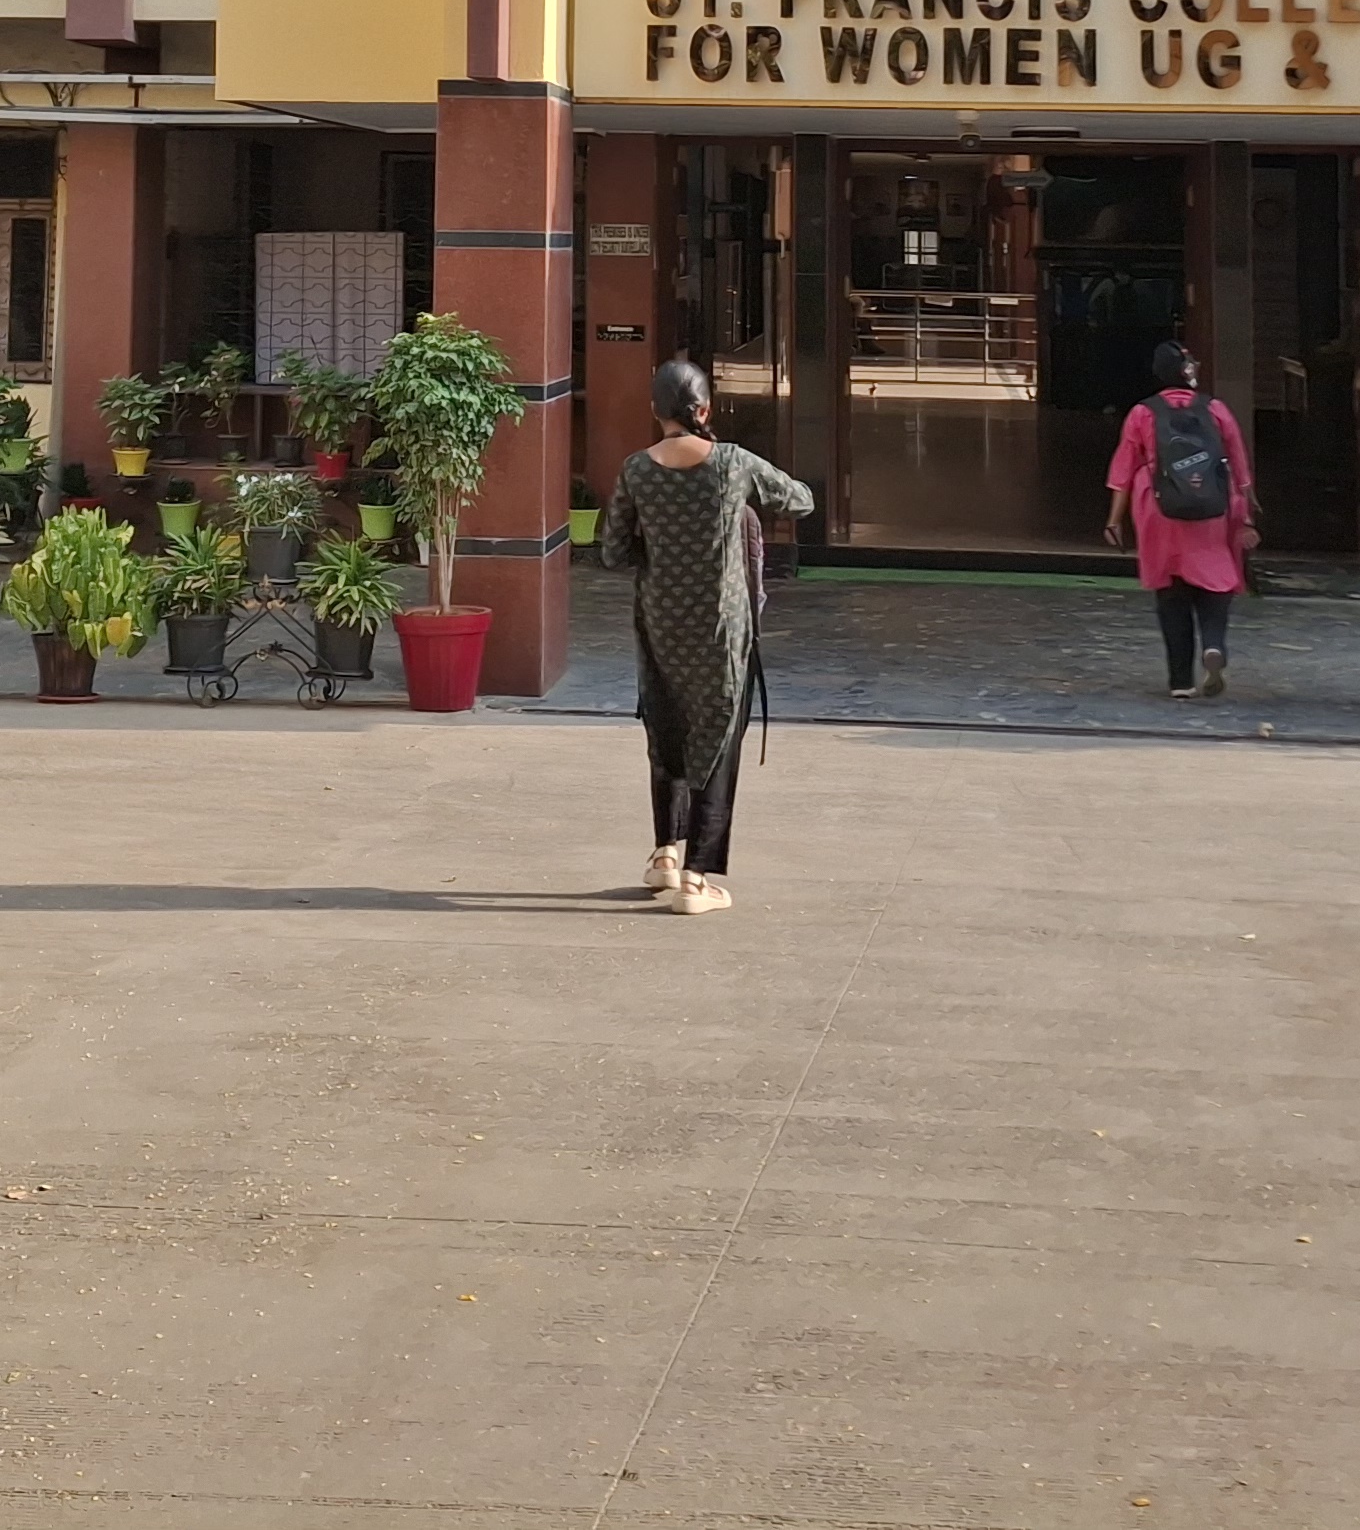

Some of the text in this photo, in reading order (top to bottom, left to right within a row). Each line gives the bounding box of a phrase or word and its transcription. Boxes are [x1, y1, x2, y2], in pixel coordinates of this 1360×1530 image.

[646, 24, 785, 84] FOR
[820, 26, 1098, 87] WOMEN
[1141, 29, 1243, 89] UG
[1284, 30, 1331, 90] &
